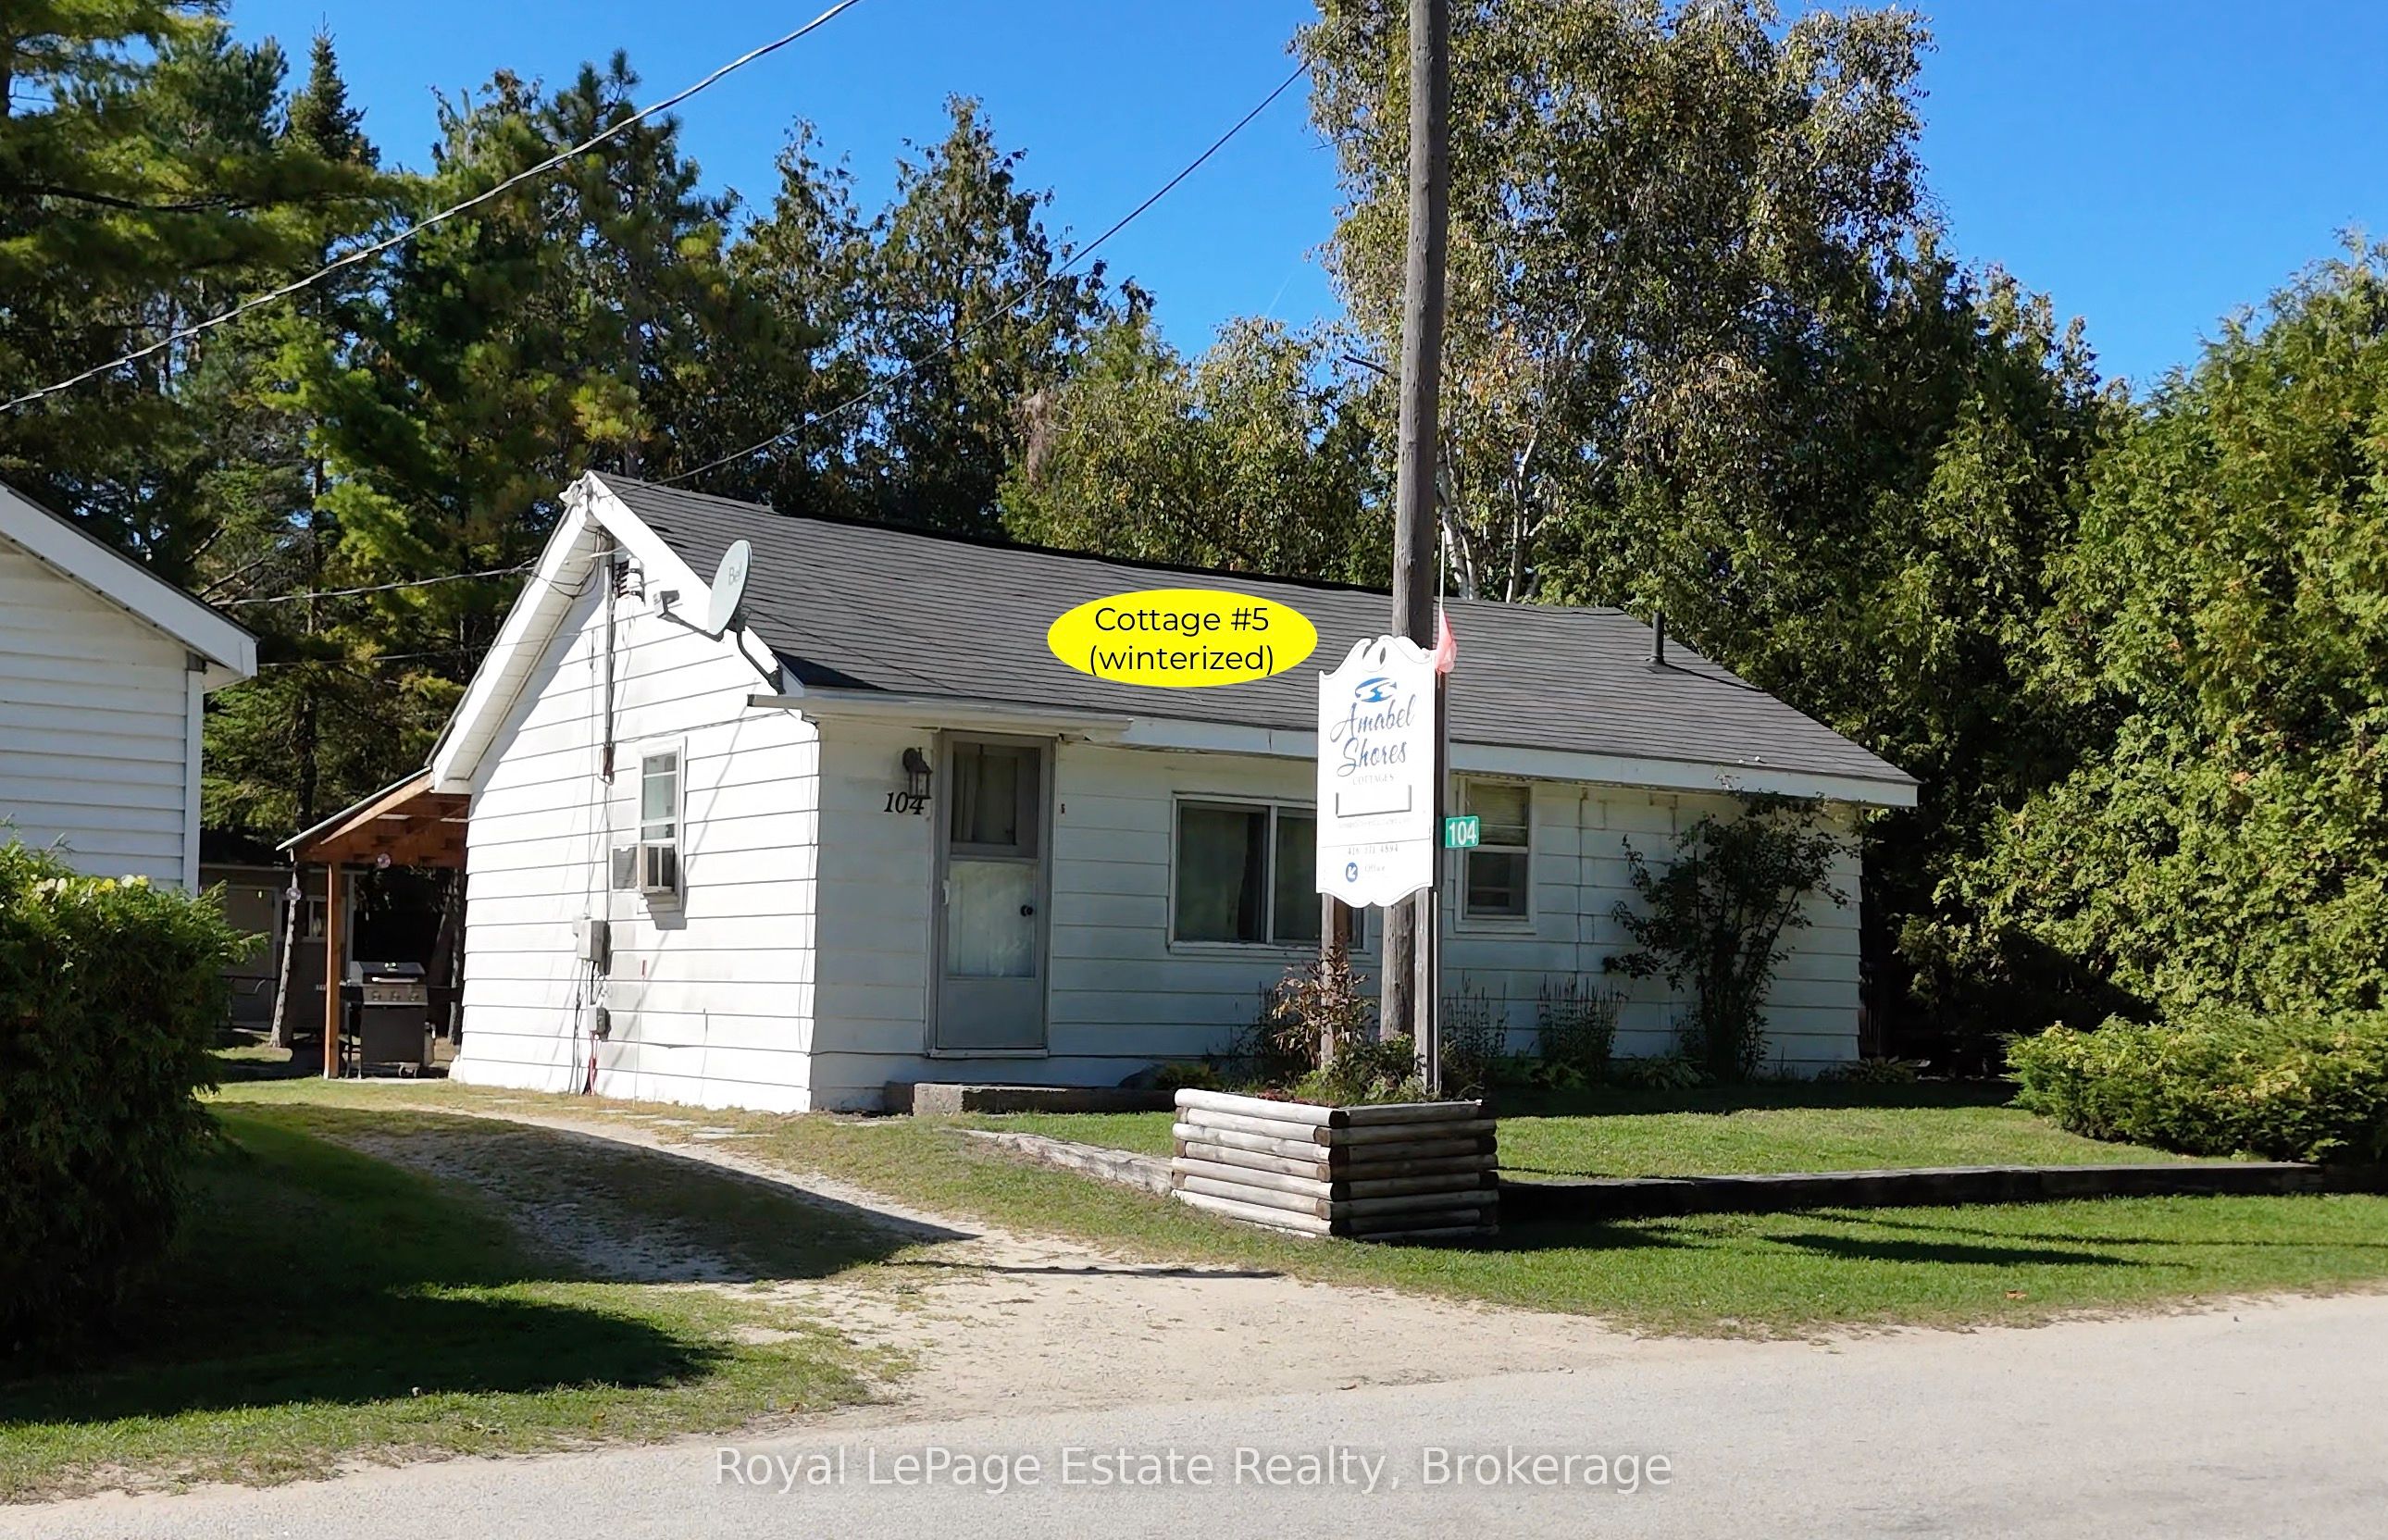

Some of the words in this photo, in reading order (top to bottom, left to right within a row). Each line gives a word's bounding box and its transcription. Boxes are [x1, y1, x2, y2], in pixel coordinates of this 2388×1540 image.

[1329, 694, 1416, 742] Amabel
[1337, 738, 1407, 777] Shores
[884, 792, 924, 814] 104
[1449, 820, 1476, 846] 104
